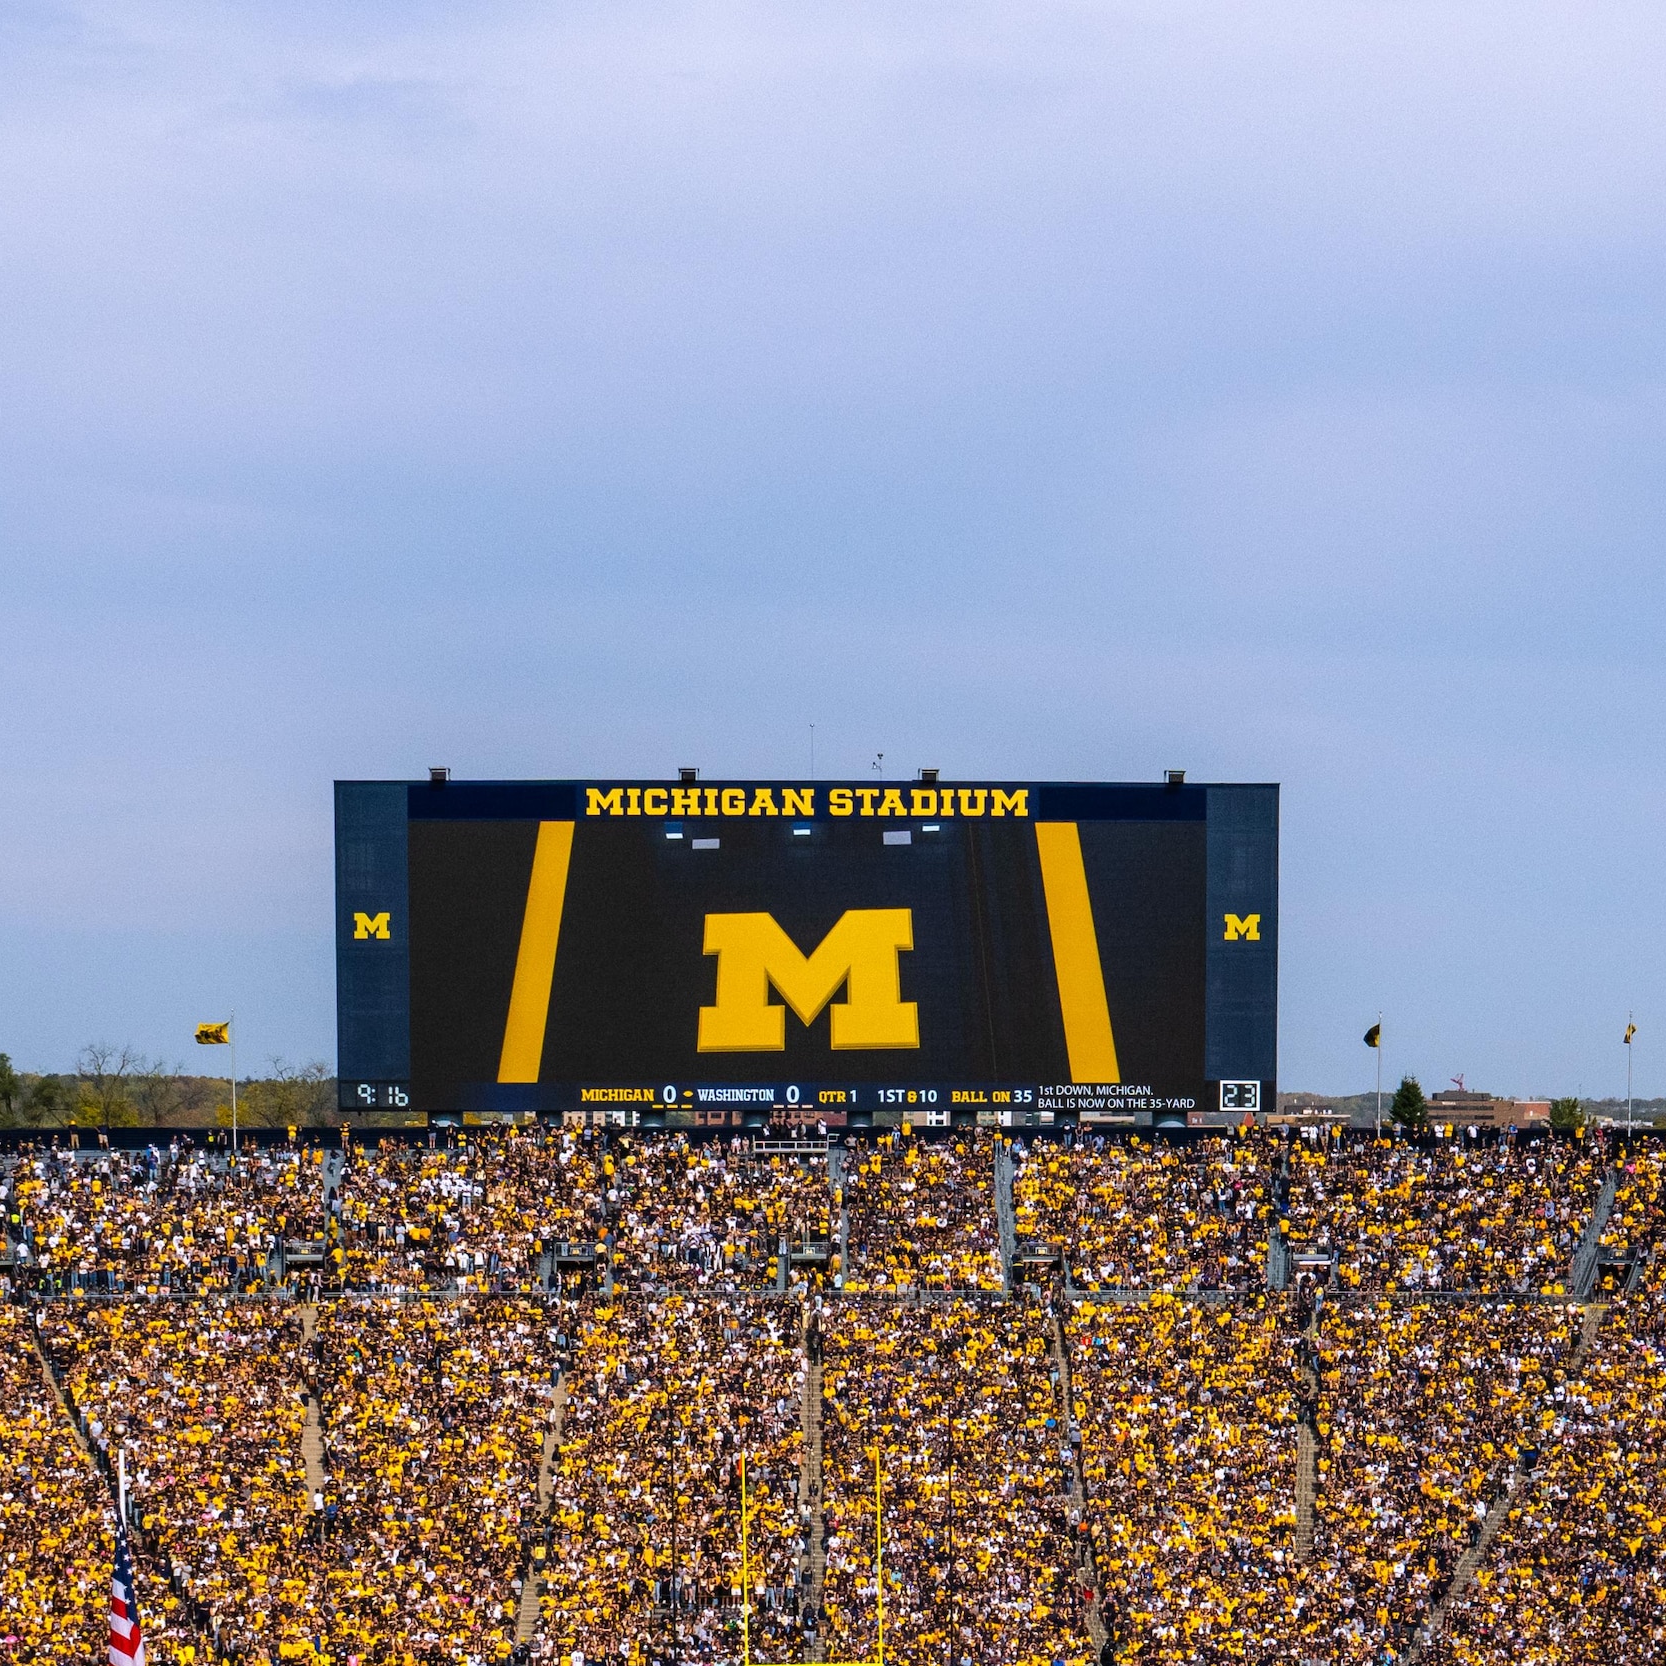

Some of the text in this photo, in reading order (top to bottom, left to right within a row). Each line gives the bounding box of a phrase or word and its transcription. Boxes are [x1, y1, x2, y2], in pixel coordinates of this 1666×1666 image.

[585, 788, 1029, 817] MICHIGAN STADIUM
[353, 912, 390, 939] M
[1224, 914, 1261, 941] M
[696, 908, 920, 1053] M
[358, 1084, 408, 1106] 9:16
[581, 1085, 676, 1103] MICHIGAN 0
[698, 1085, 800, 1103] WASHINGTON 0
[819, 1090, 857, 1103] QTR 1
[878, 1090, 938, 1102] 1ST & 10
[952, 1090, 1033, 1102] BALL ON 35
[1039, 1086, 1154, 1097] 1st DOWN, MICHIGAN.
[1224, 1085, 1255, 1107] 23
[1038, 1098, 1195, 1109] BALL IS NOW ON THE 35-YARD
